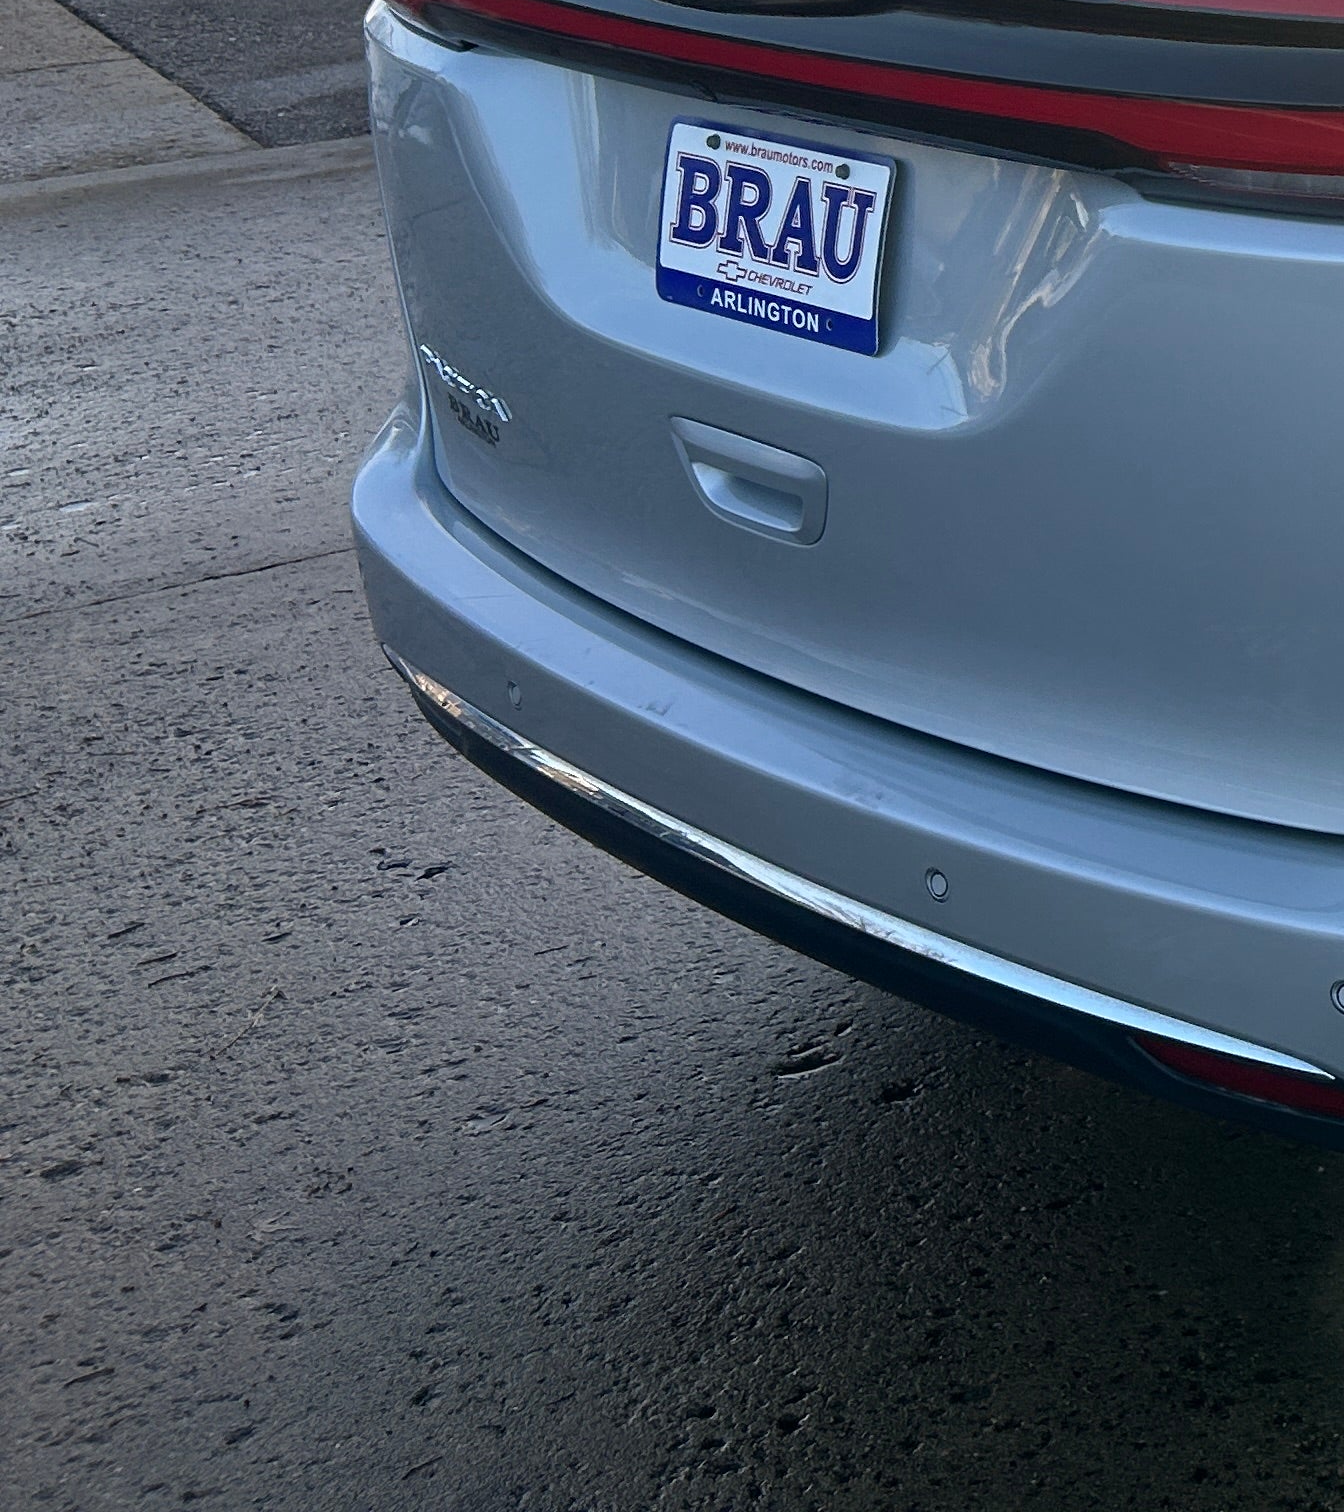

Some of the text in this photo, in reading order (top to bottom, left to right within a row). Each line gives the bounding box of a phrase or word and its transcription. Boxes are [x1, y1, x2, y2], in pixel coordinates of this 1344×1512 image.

[725, 140, 834, 174] www.braumotors.com
[669, 151, 877, 284] BRAU
[747, 270, 813, 295] CHEVROLET
[711, 287, 819, 332] ARLINGTON
